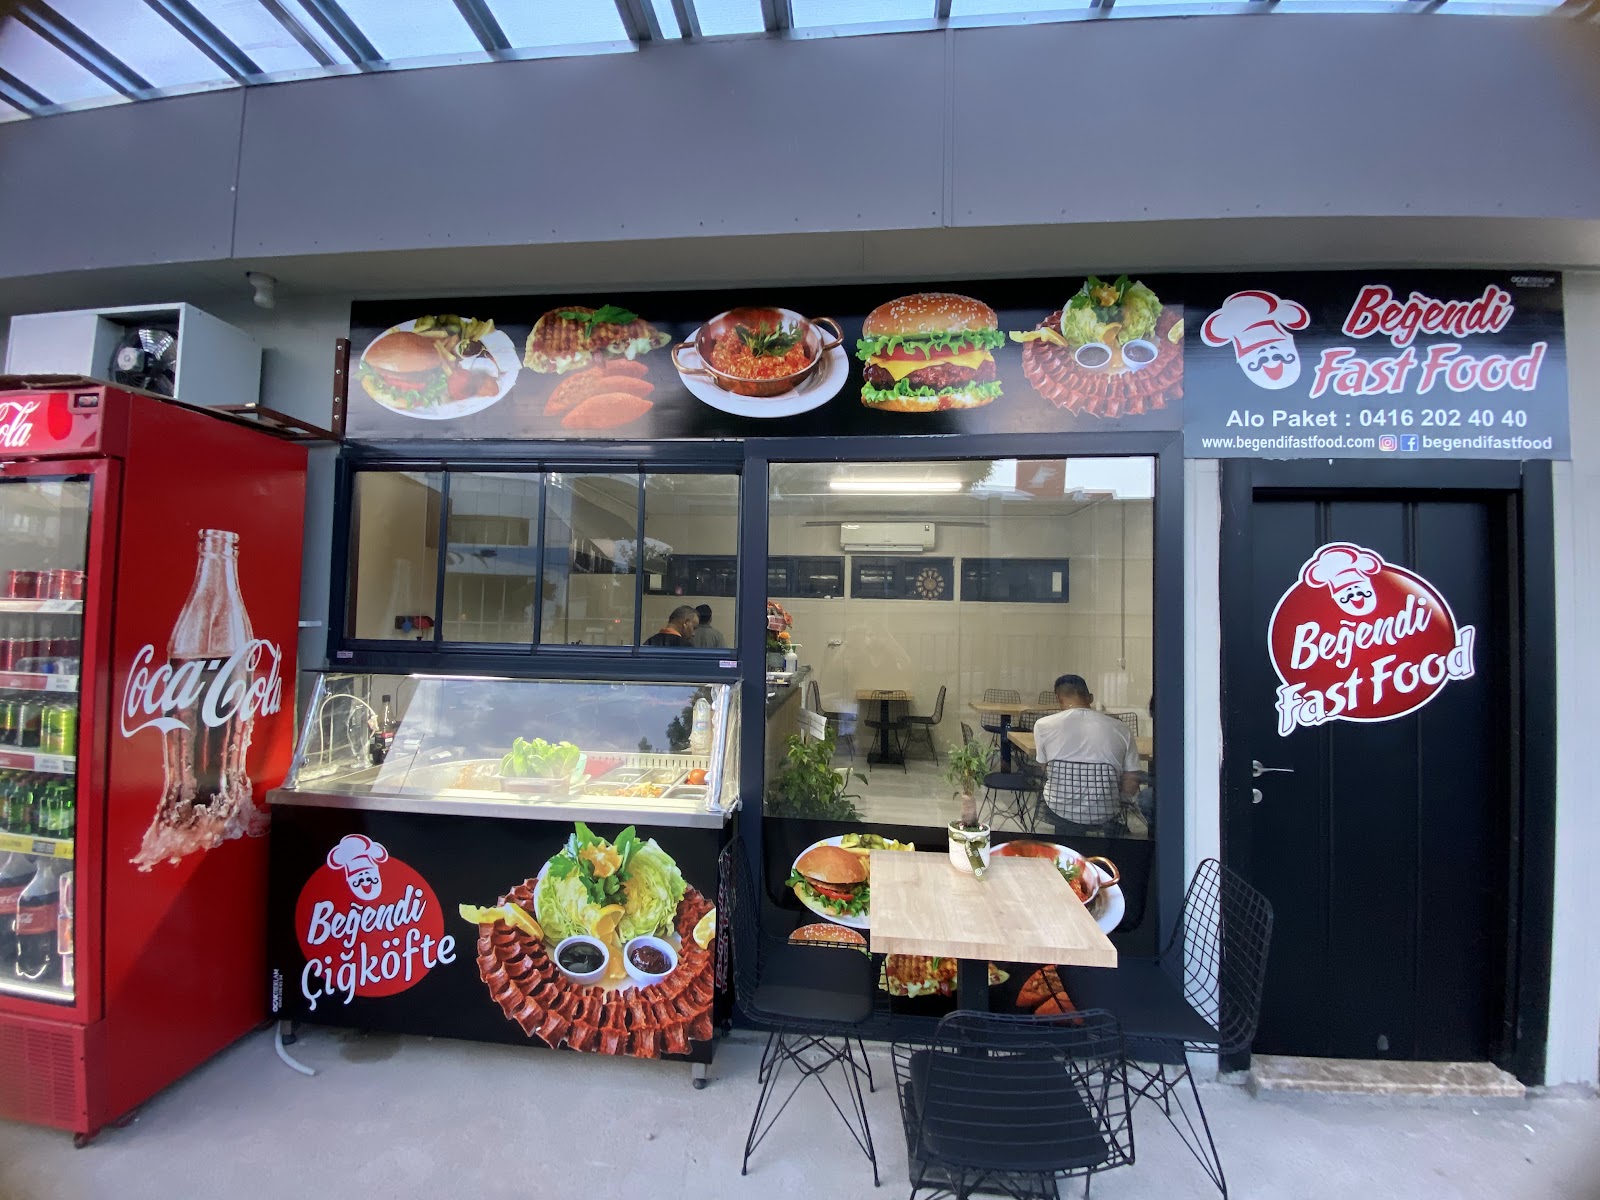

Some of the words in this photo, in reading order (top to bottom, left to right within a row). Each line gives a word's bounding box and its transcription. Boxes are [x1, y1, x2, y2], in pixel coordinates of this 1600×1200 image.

[1310, 346, 1418, 399] Fast
[1416, 341, 1548, 395] Food
[1202, 435, 1375, 451] www.begendifastfood.com
[1422, 435, 1552, 451] begendifastfood
[1226, 410, 1265, 427] Alo
[1272, 409, 1338, 428] Paket
[1359, 409, 1414, 427] 0416
[1421, 409, 1461, 427] 202
[1468, 409, 1494, 427] 40
[1501, 409, 1528, 428] 40
[120, 638, 283, 738] Coca-Cola
[1275, 667, 1363, 737] Fast
[1370, 624, 1476, 705] Food
[301, 928, 457, 1011] Çiğköfte
